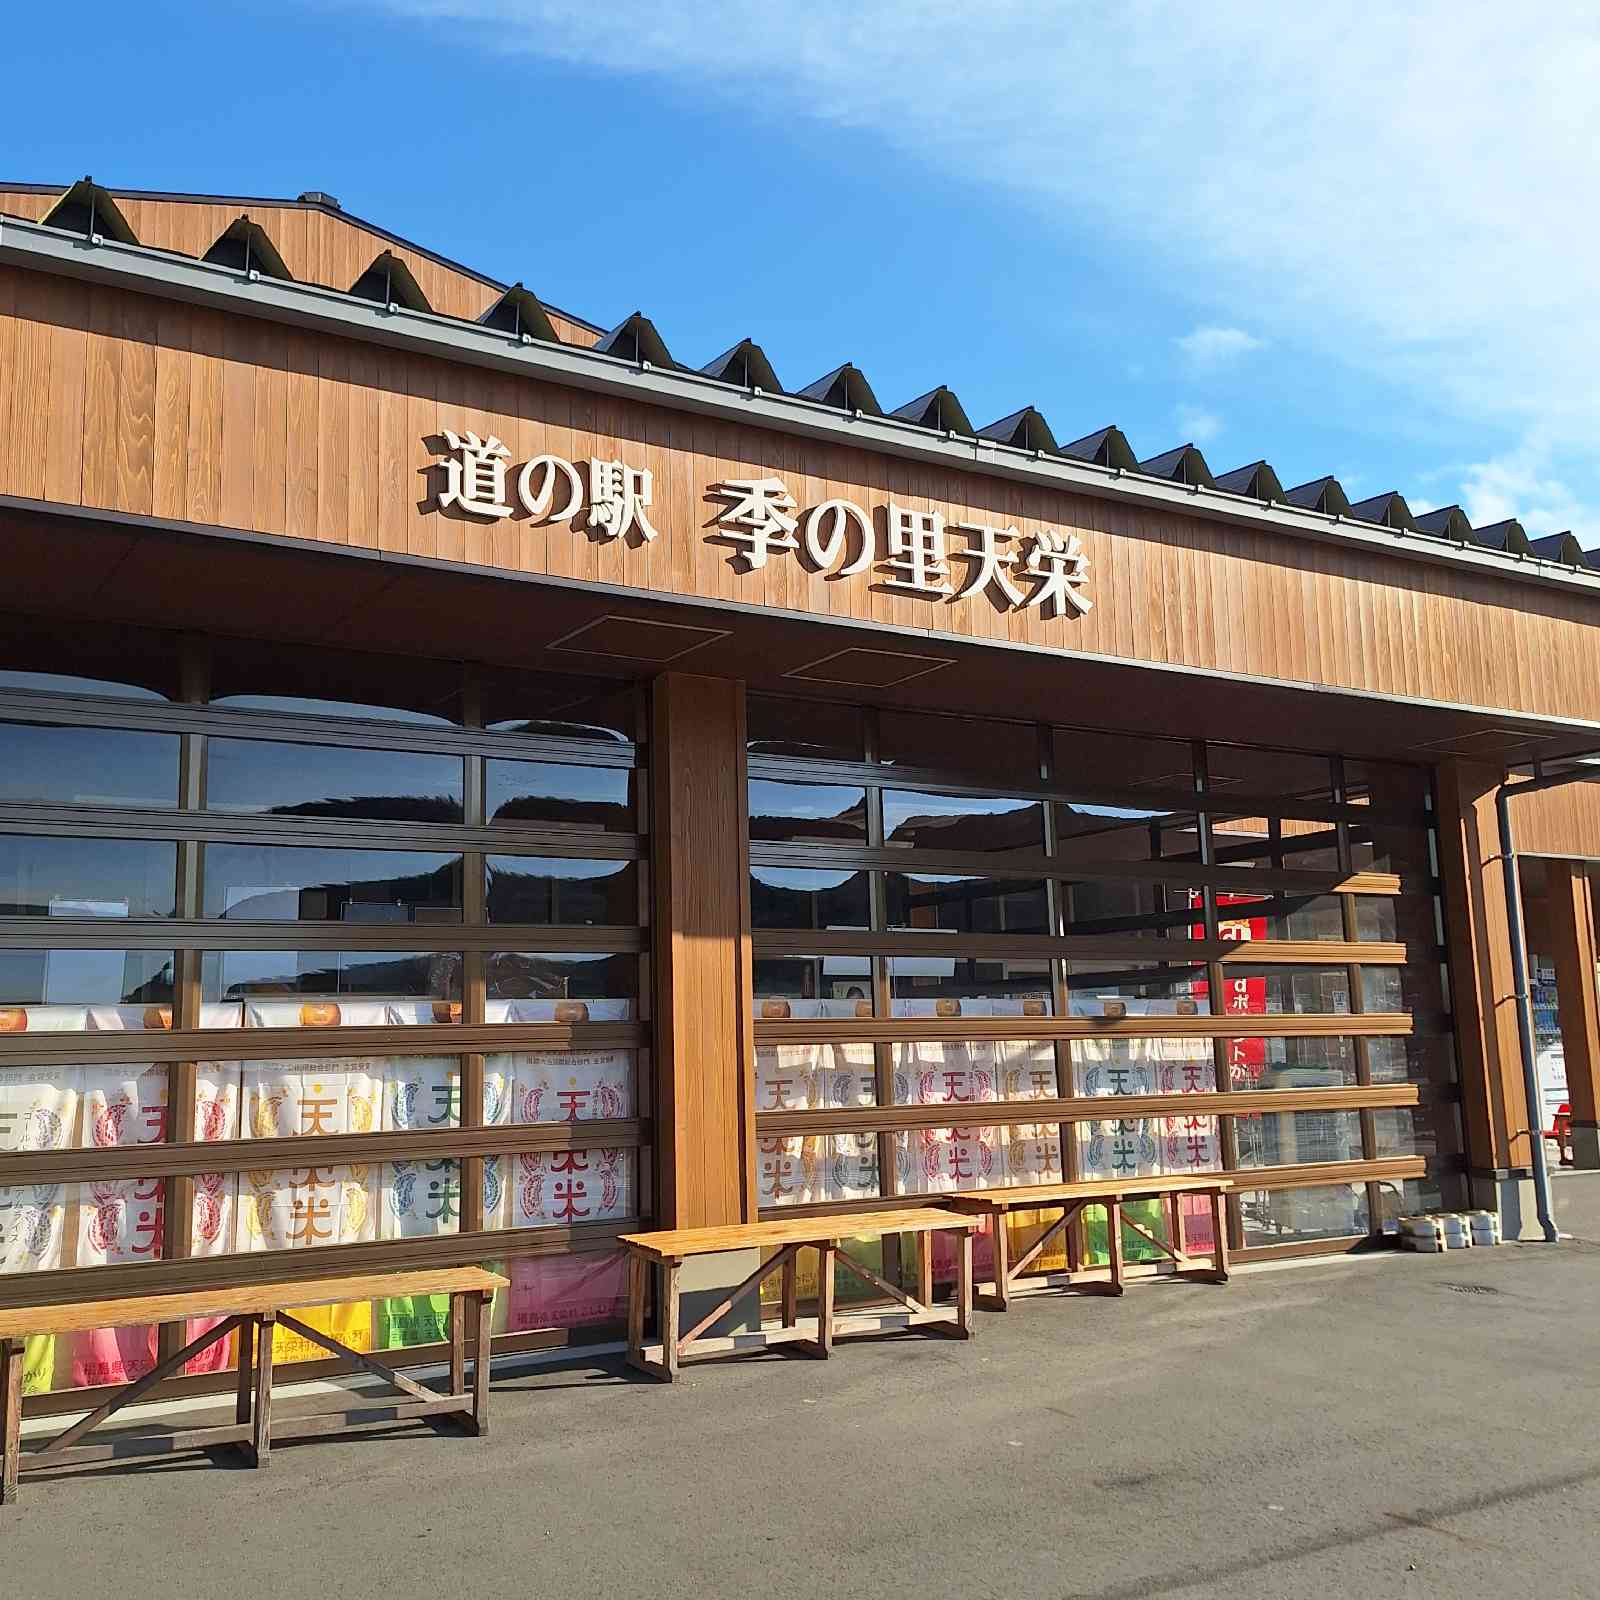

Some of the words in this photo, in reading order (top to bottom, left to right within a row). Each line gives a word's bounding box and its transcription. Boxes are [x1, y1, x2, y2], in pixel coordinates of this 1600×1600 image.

[438, 429, 658, 541] 道の駅
[718, 477, 1094, 617] 季の里天栄
